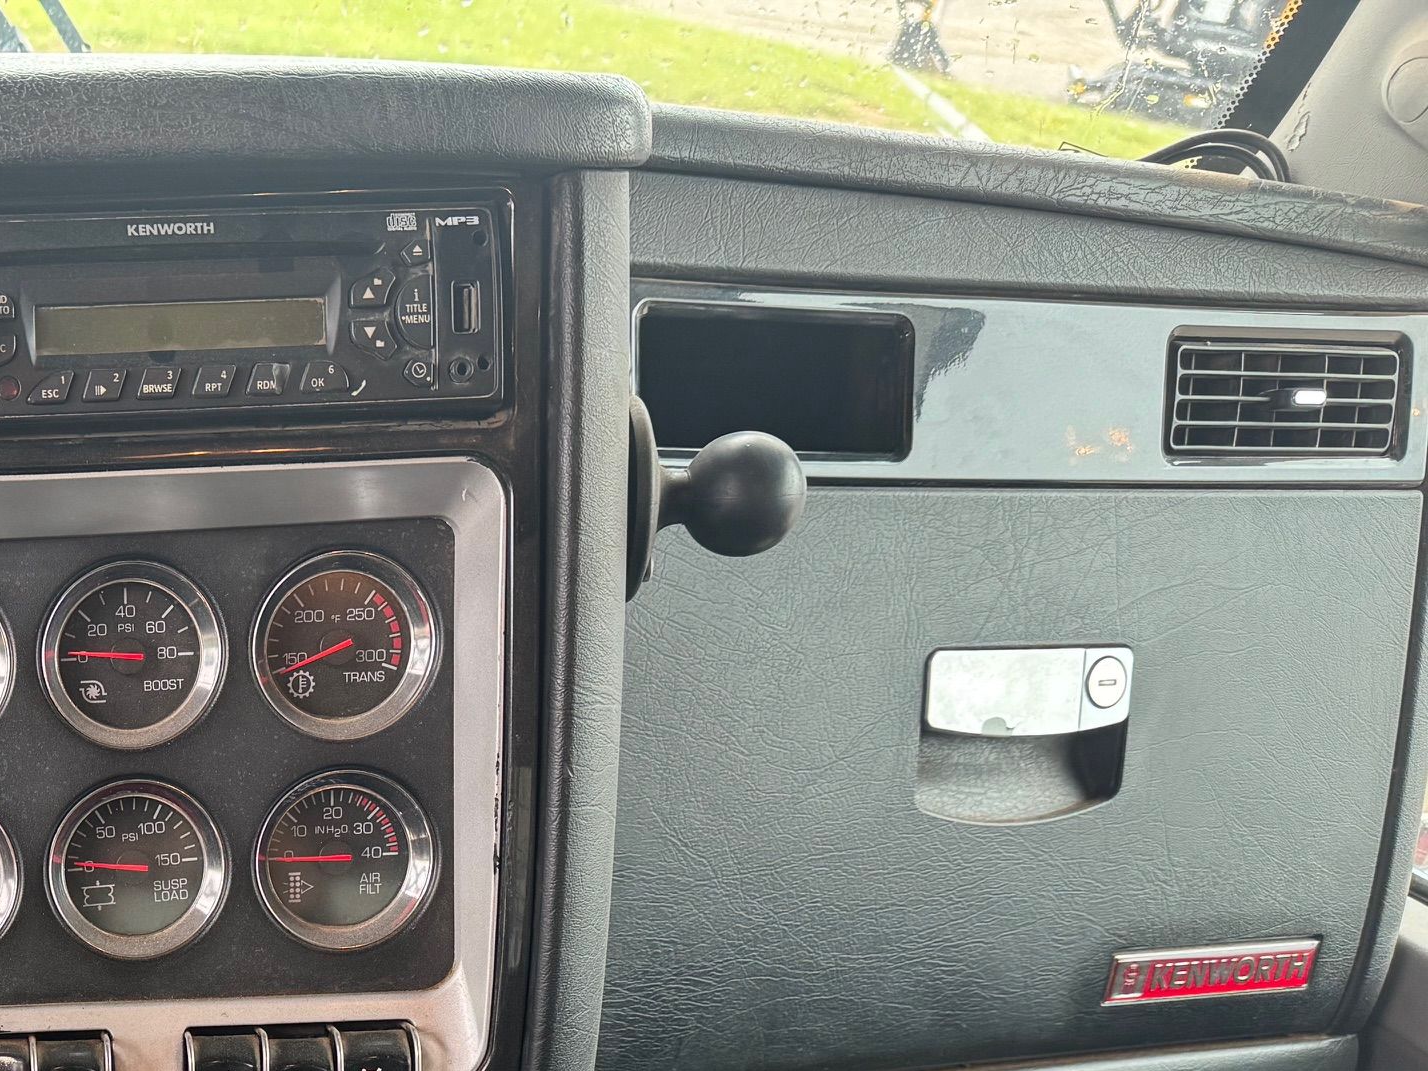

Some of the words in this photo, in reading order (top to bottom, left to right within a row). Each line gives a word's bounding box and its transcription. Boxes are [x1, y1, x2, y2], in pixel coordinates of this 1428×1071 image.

[435, 216, 479, 227] MP3
[127, 222, 214, 236] KENWORTH
[405, 303, 428, 313] TITLE
[167, 371, 173, 380] 3
[220, 370, 227, 379] 4
[328, 365, 335, 374] 6
[60, 375, 65, 384] 1
[113, 373, 119, 382] 2
[311, 378, 325, 387] OK
[143, 384, 173, 394] BRWSE
[205, 382, 222, 391] RPT
[41, 389, 59, 398] ESC
[115, 605, 136, 618] 40
[294, 609, 324, 623] 200
[346, 608, 375, 621] 250
[87, 623, 108, 636] 20
[118, 623, 135, 633] PSI
[146, 620, 166, 633] 60
[157, 646, 177, 659] 80
[283, 652, 308, 665] 150
[355, 649, 386, 662] 300
[343, 670, 385, 683] TRANS
[144, 678, 185, 692] BOOST
[323, 807, 343, 819] 20
[96, 826, 116, 839] 50
[122, 833, 139, 842] PSI
[137, 821, 165, 835] 100
[290, 825, 307, 838] 10
[353, 822, 373, 835] 30
[361, 846, 382, 859] 40
[154, 852, 181, 866] 150
[360, 872, 381, 883] AIR
[153, 878, 188, 890] SUSP
[359, 883, 382, 895] FILT
[154, 890, 189, 902] LOAD
[1150, 953, 1310, 991] KENWORTH
